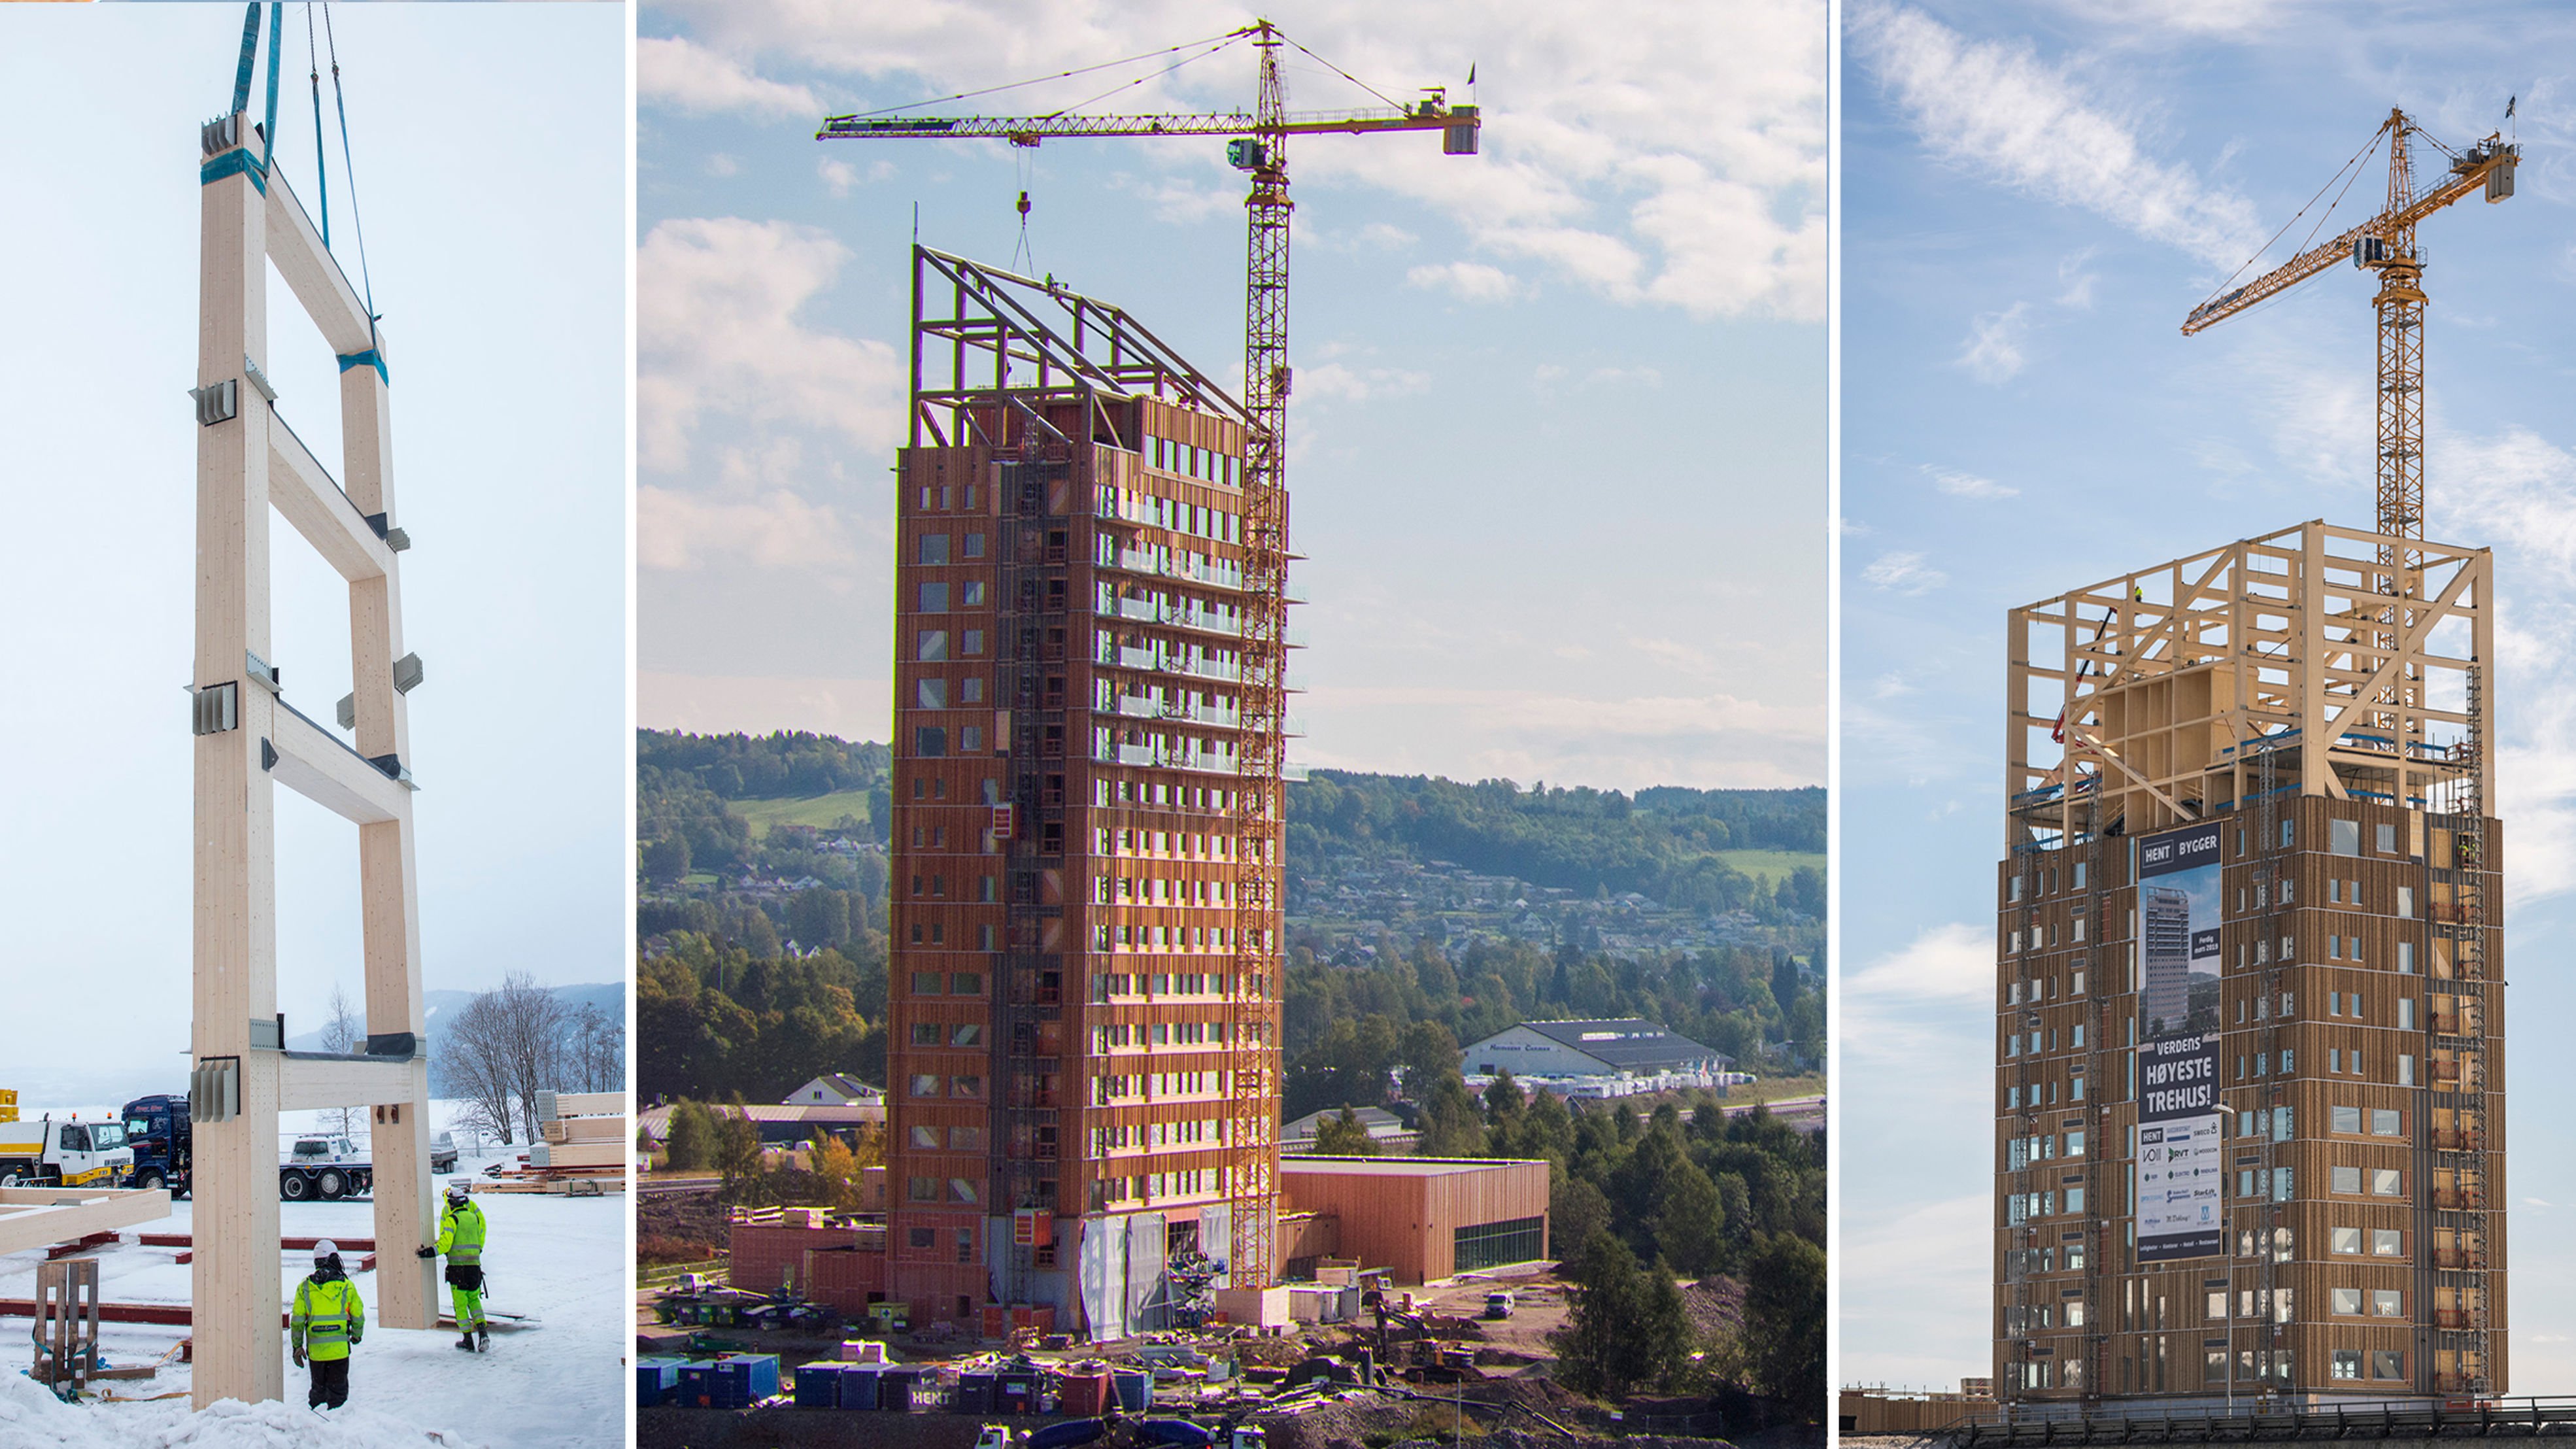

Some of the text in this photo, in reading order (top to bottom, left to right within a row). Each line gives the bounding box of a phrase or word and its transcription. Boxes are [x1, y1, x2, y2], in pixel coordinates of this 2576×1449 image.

[2145, 835, 2217, 862] HENT BYGGER
[2157, 1036, 2201, 1055] VERDENS
[2147, 1057, 2212, 1085] HØYESTE
[2146, 1083, 2211, 1114] TREHUS!
[2143, 1130, 2161, 1142] HENT
[2174, 1149, 2189, 1158] RVT
